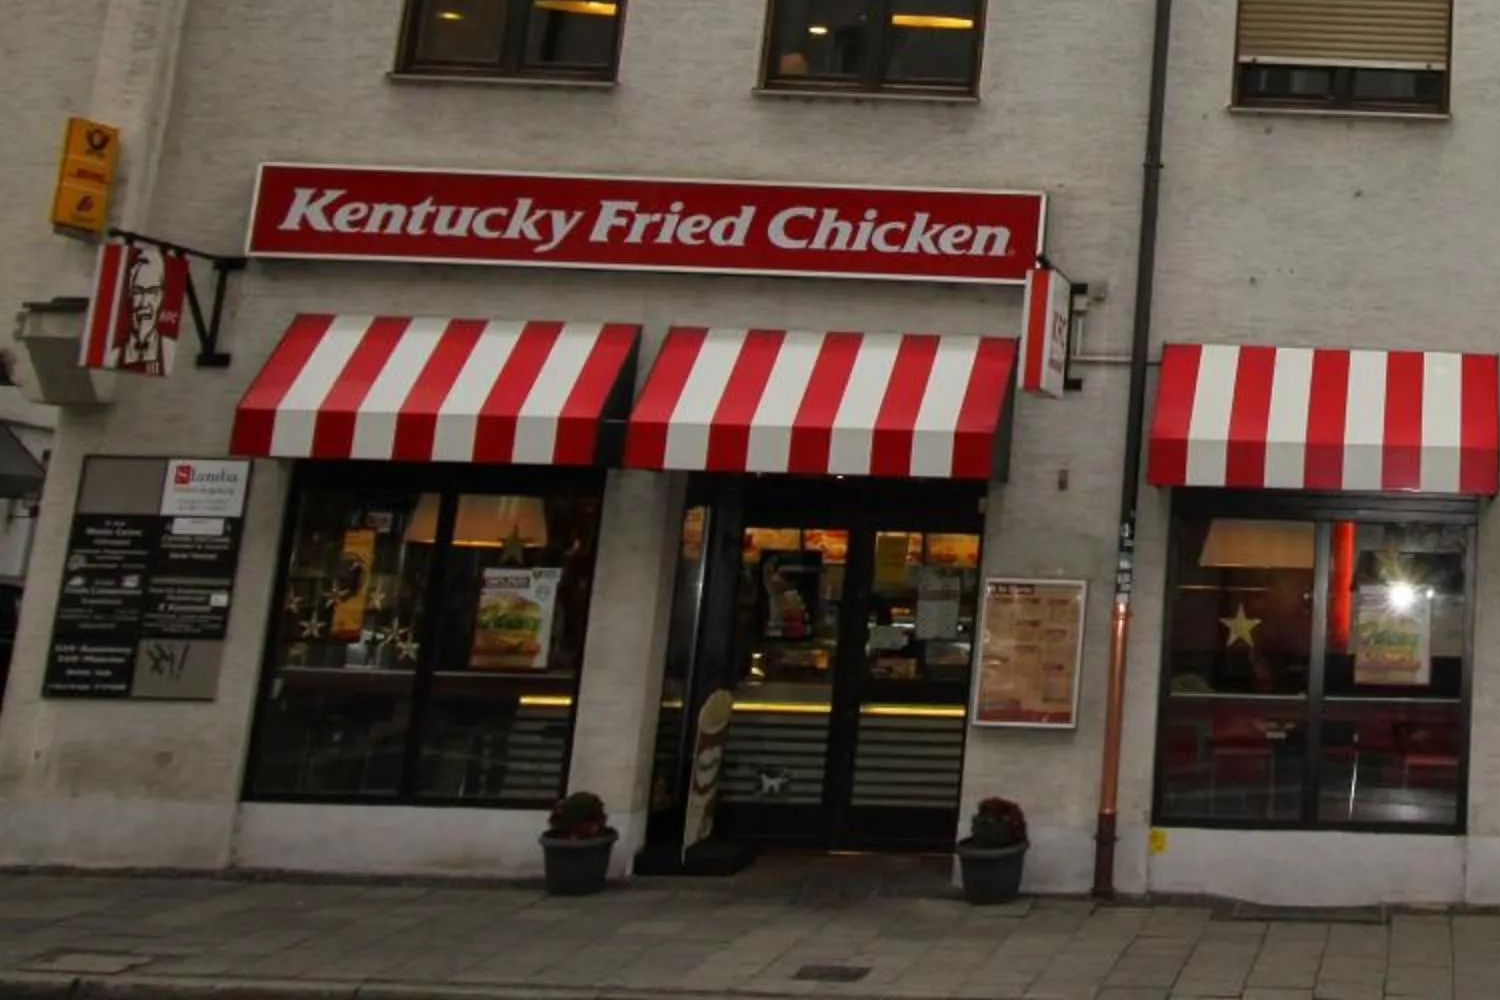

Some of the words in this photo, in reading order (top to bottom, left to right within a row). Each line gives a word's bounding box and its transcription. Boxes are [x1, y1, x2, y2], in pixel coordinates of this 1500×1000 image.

[277, 187, 583, 253] Kentucky
[588, 199, 757, 247] Fried
[767, 206, 1011, 257] Chicken
